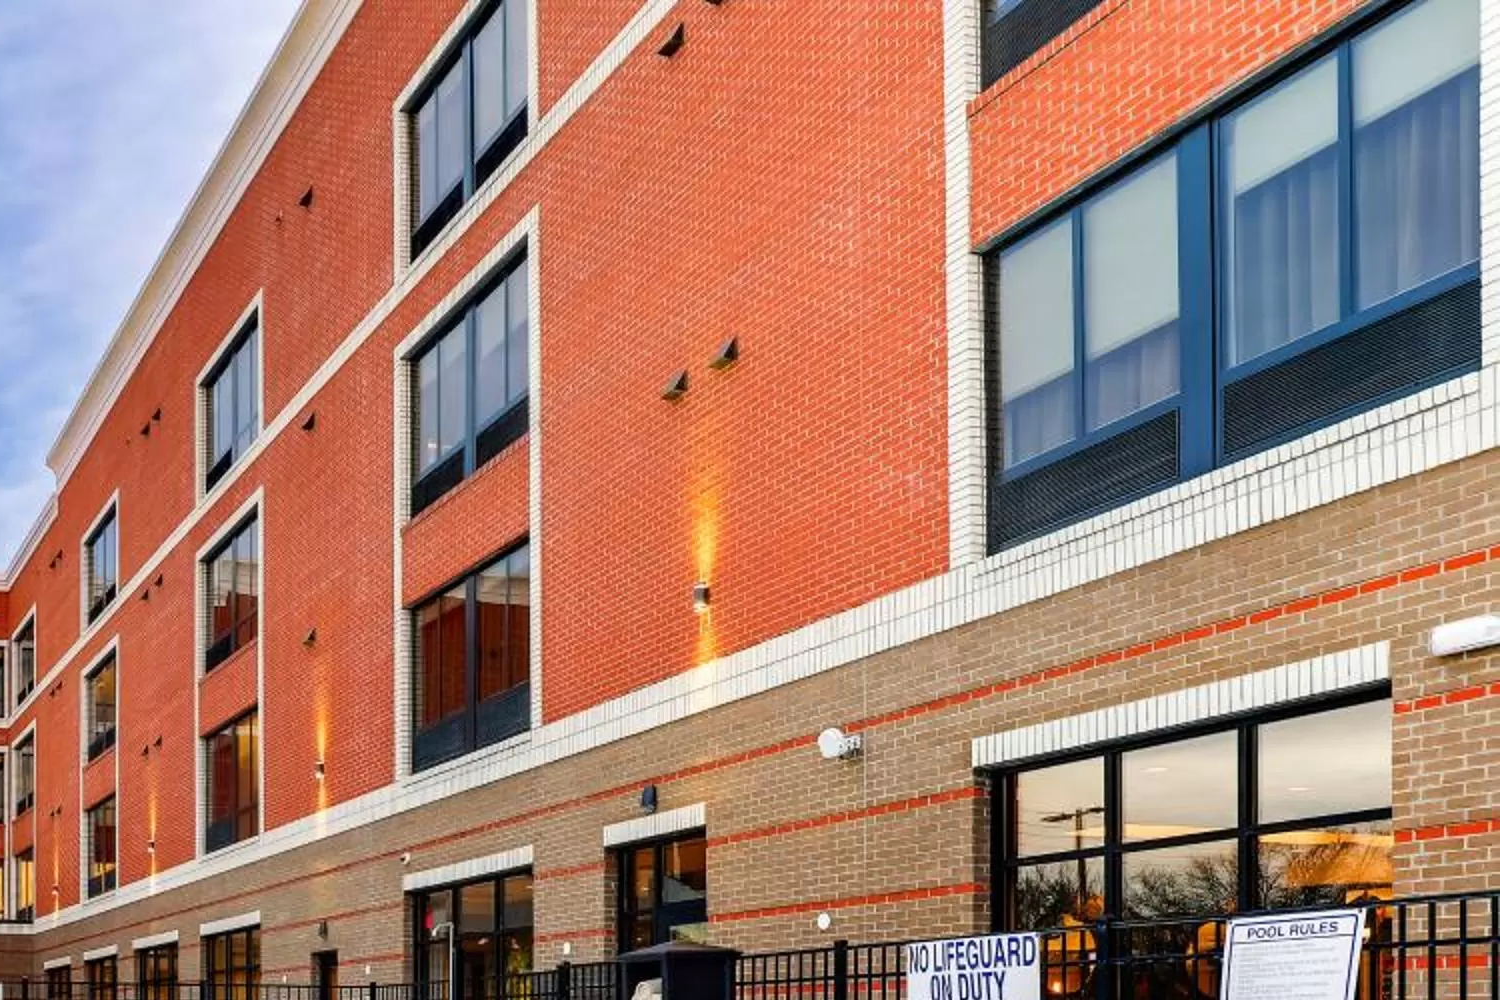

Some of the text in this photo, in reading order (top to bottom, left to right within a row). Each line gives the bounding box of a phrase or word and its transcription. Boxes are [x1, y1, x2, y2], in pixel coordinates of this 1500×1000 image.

[1247, 921, 1340, 940] POOL RULES
[909, 936, 1036, 974] NO LIFEGUARD
